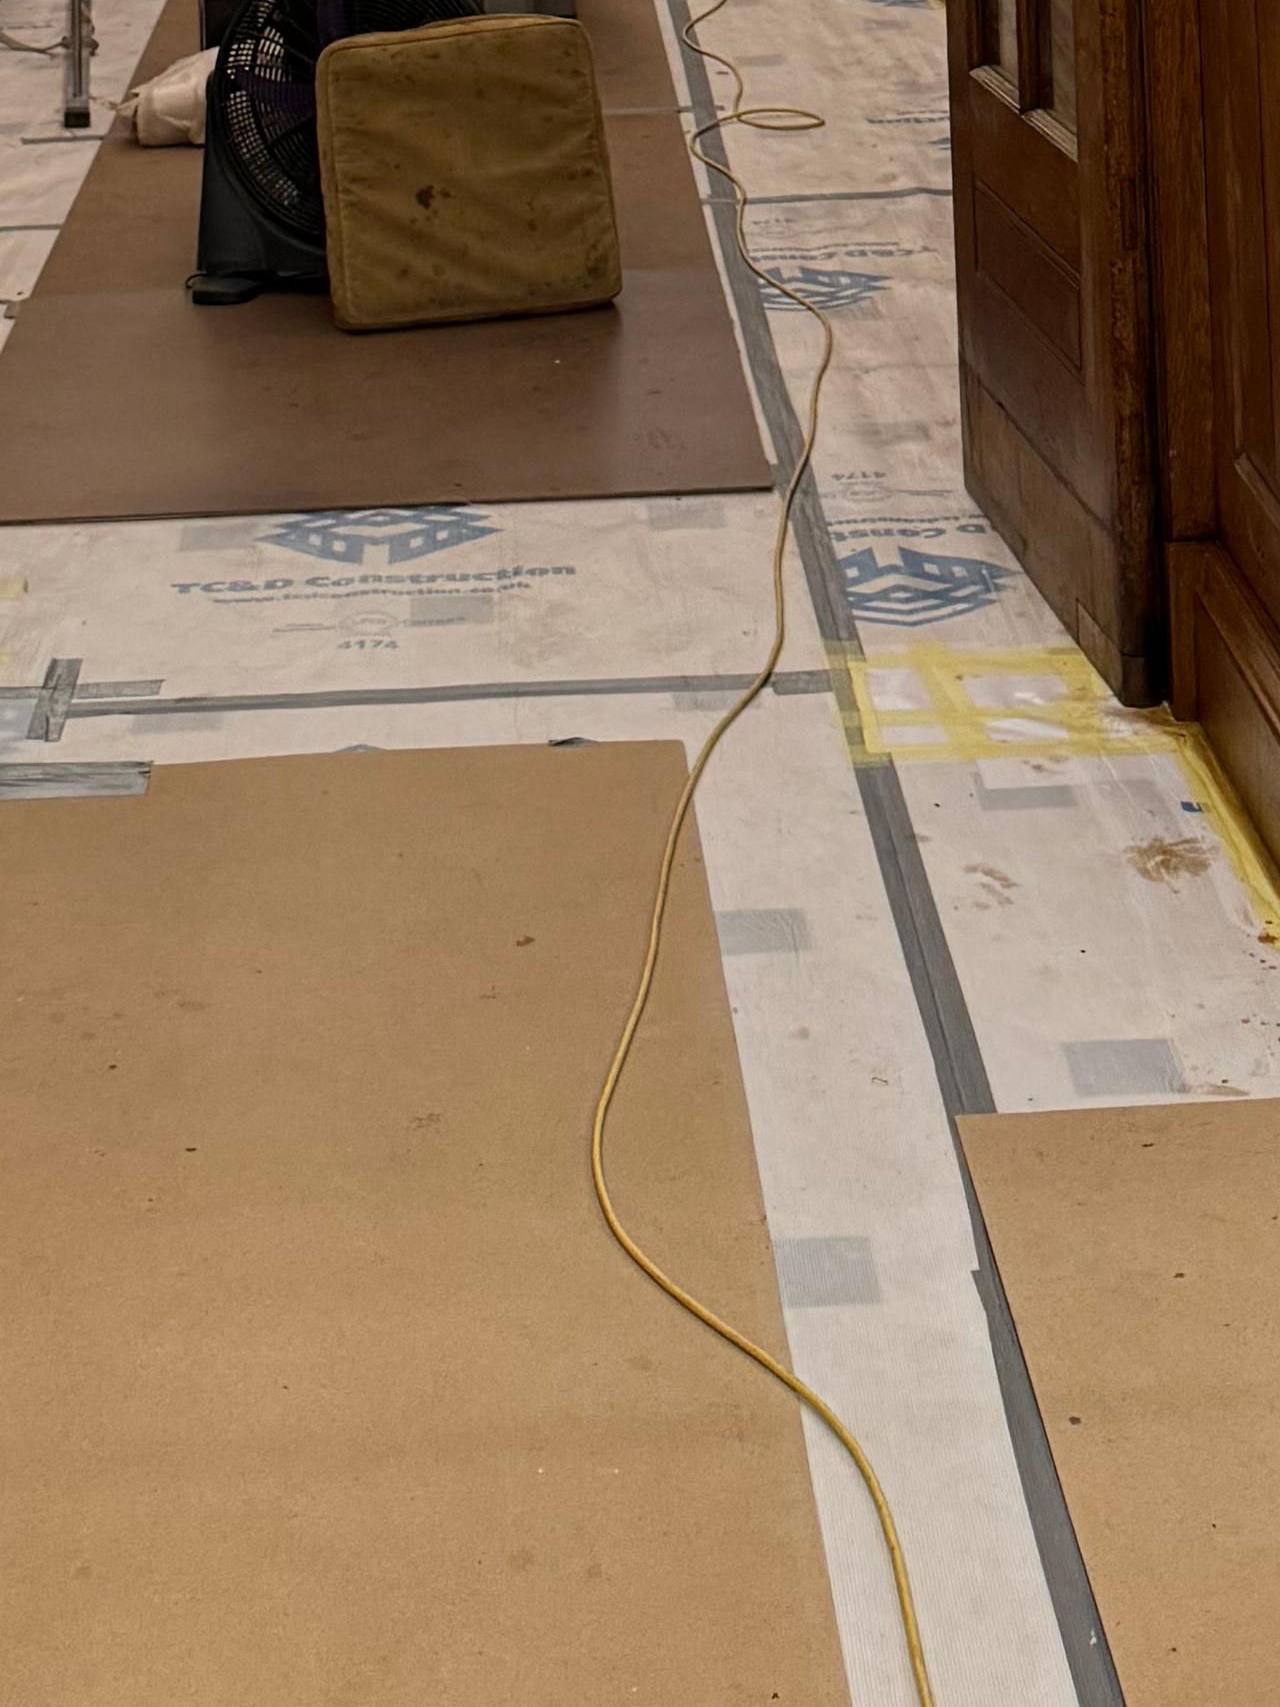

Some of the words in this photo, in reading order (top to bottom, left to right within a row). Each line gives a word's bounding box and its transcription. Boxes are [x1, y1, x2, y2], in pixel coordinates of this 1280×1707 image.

[830, 528, 947, 543] Const
[171, 578, 294, 594] TC&D
[305, 565, 576, 587] Construction
[337, 639, 400, 650] 4174
